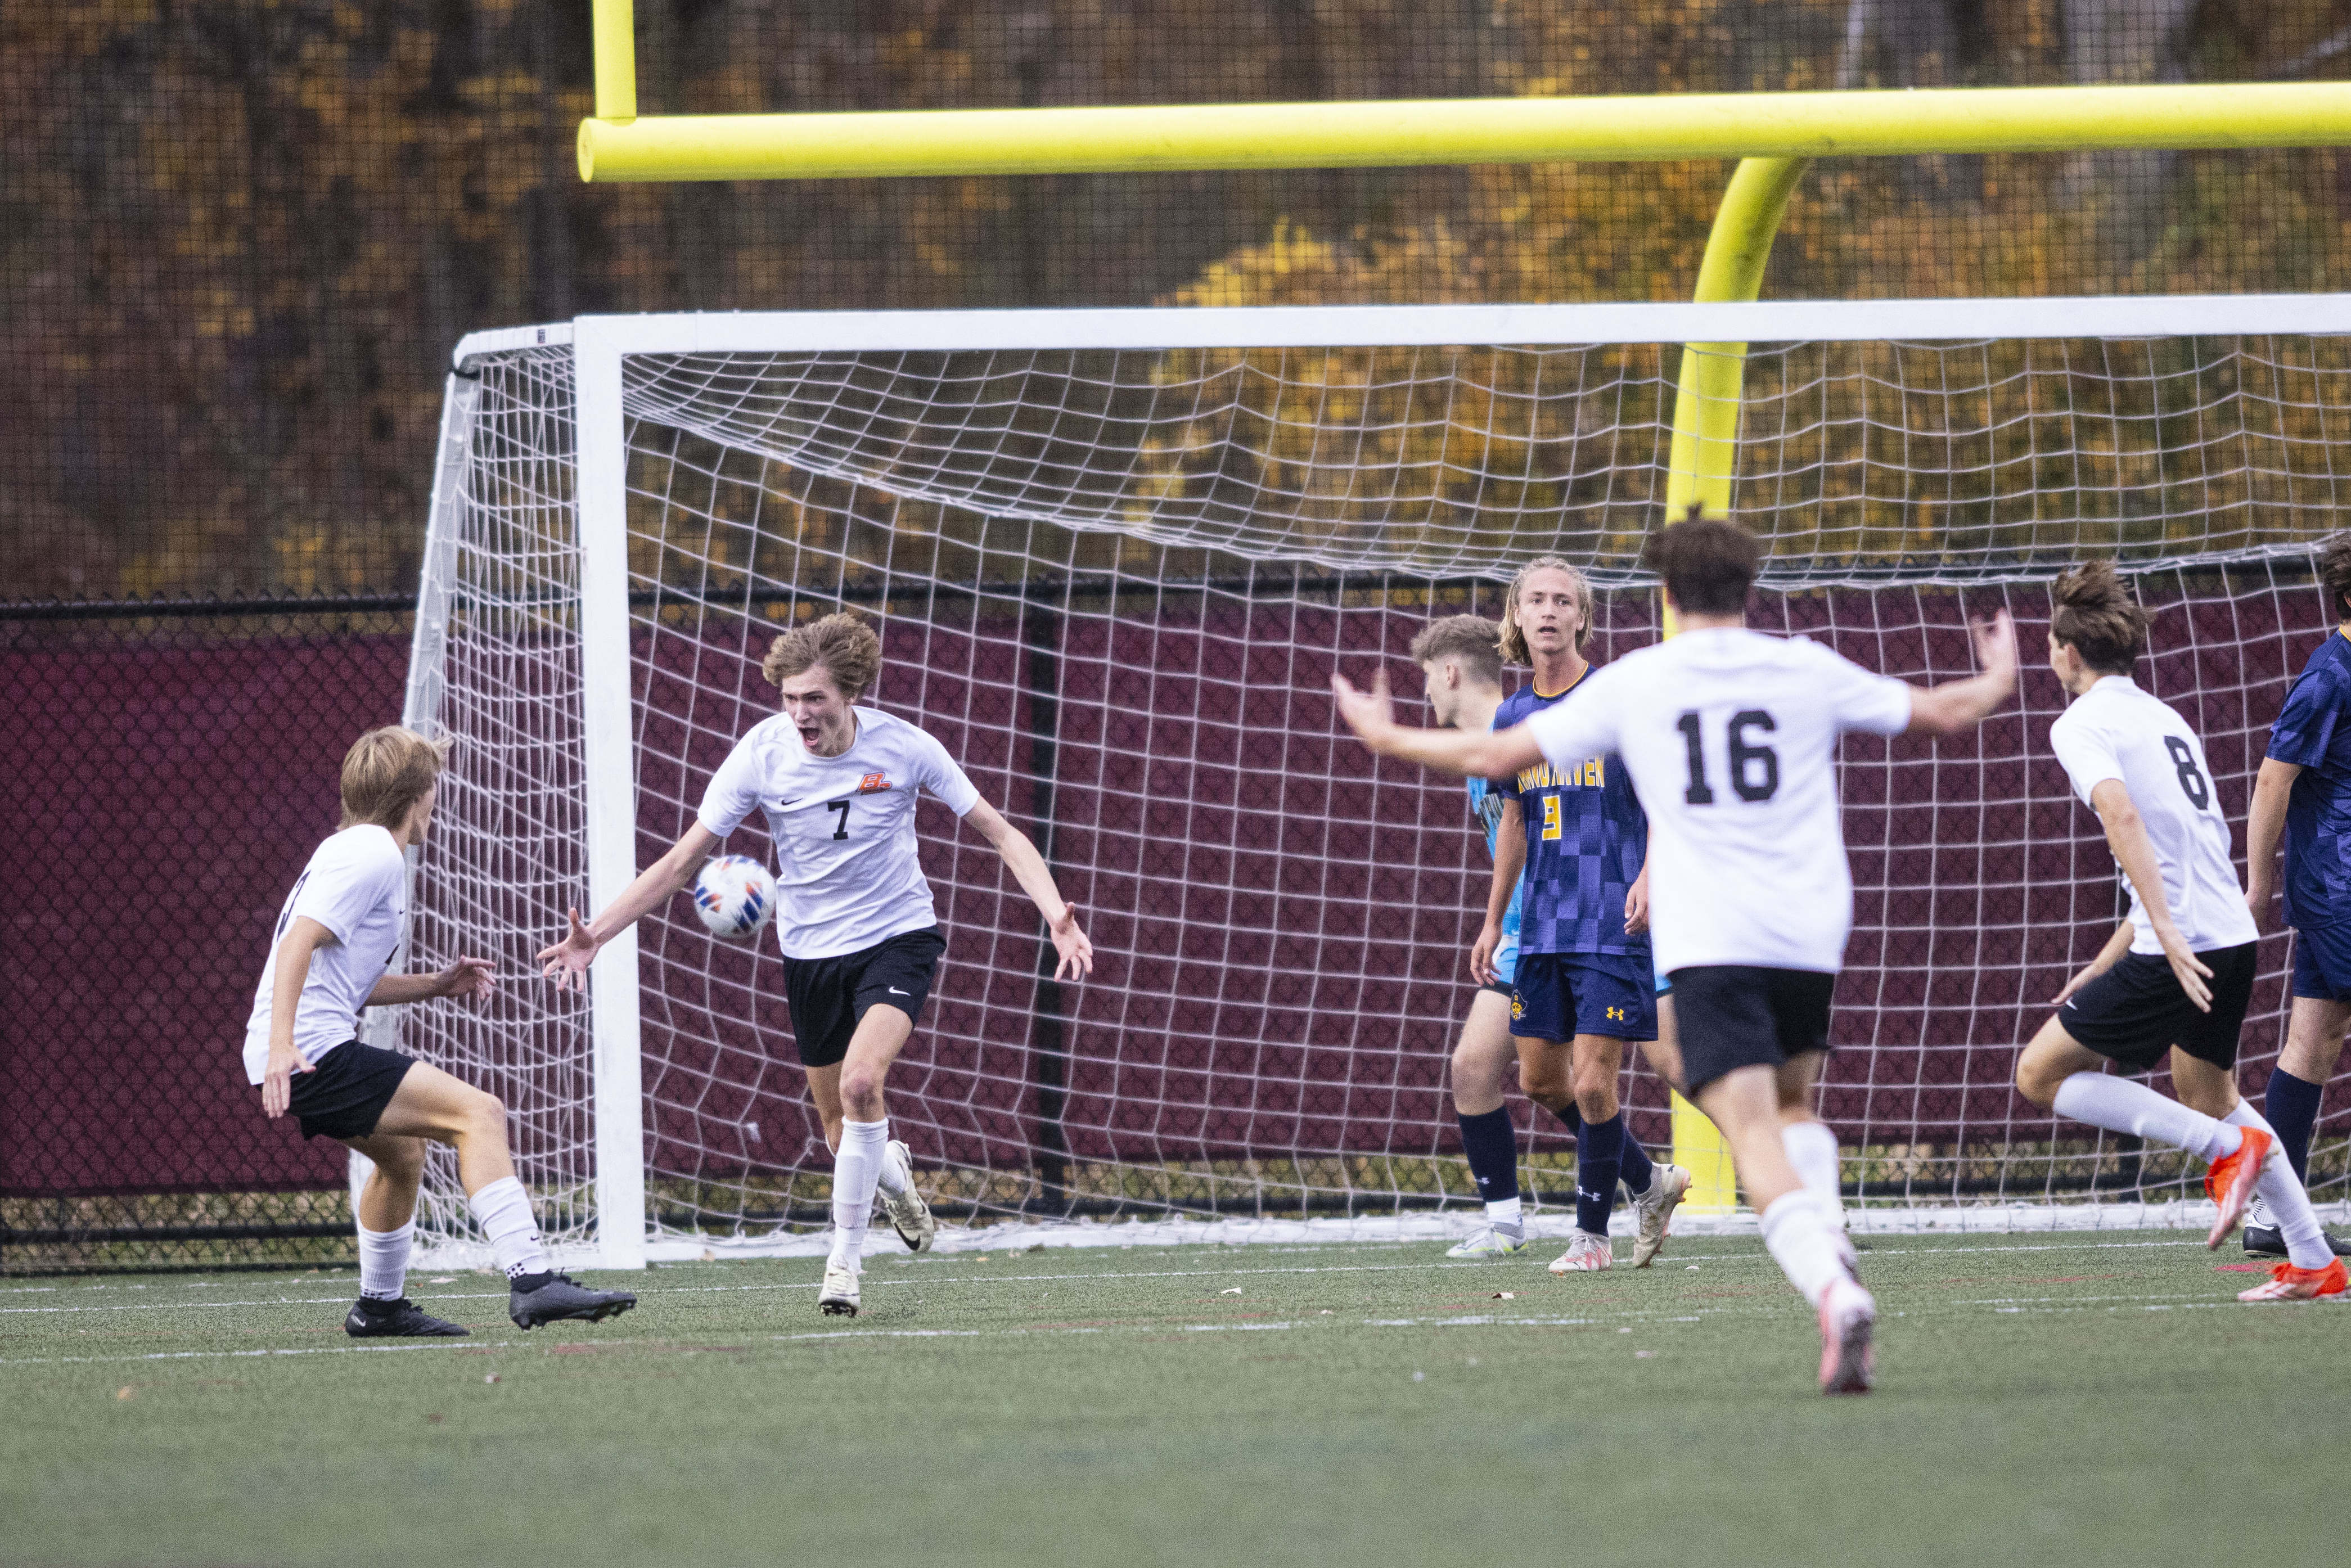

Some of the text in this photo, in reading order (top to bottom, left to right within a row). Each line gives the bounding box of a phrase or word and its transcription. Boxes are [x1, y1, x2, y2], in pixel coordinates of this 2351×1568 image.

[1678, 710, 1778, 804] 16
[2164, 735, 2209, 811] 8
[827, 800, 850, 840] 7
[1542, 795, 1562, 841] 9
